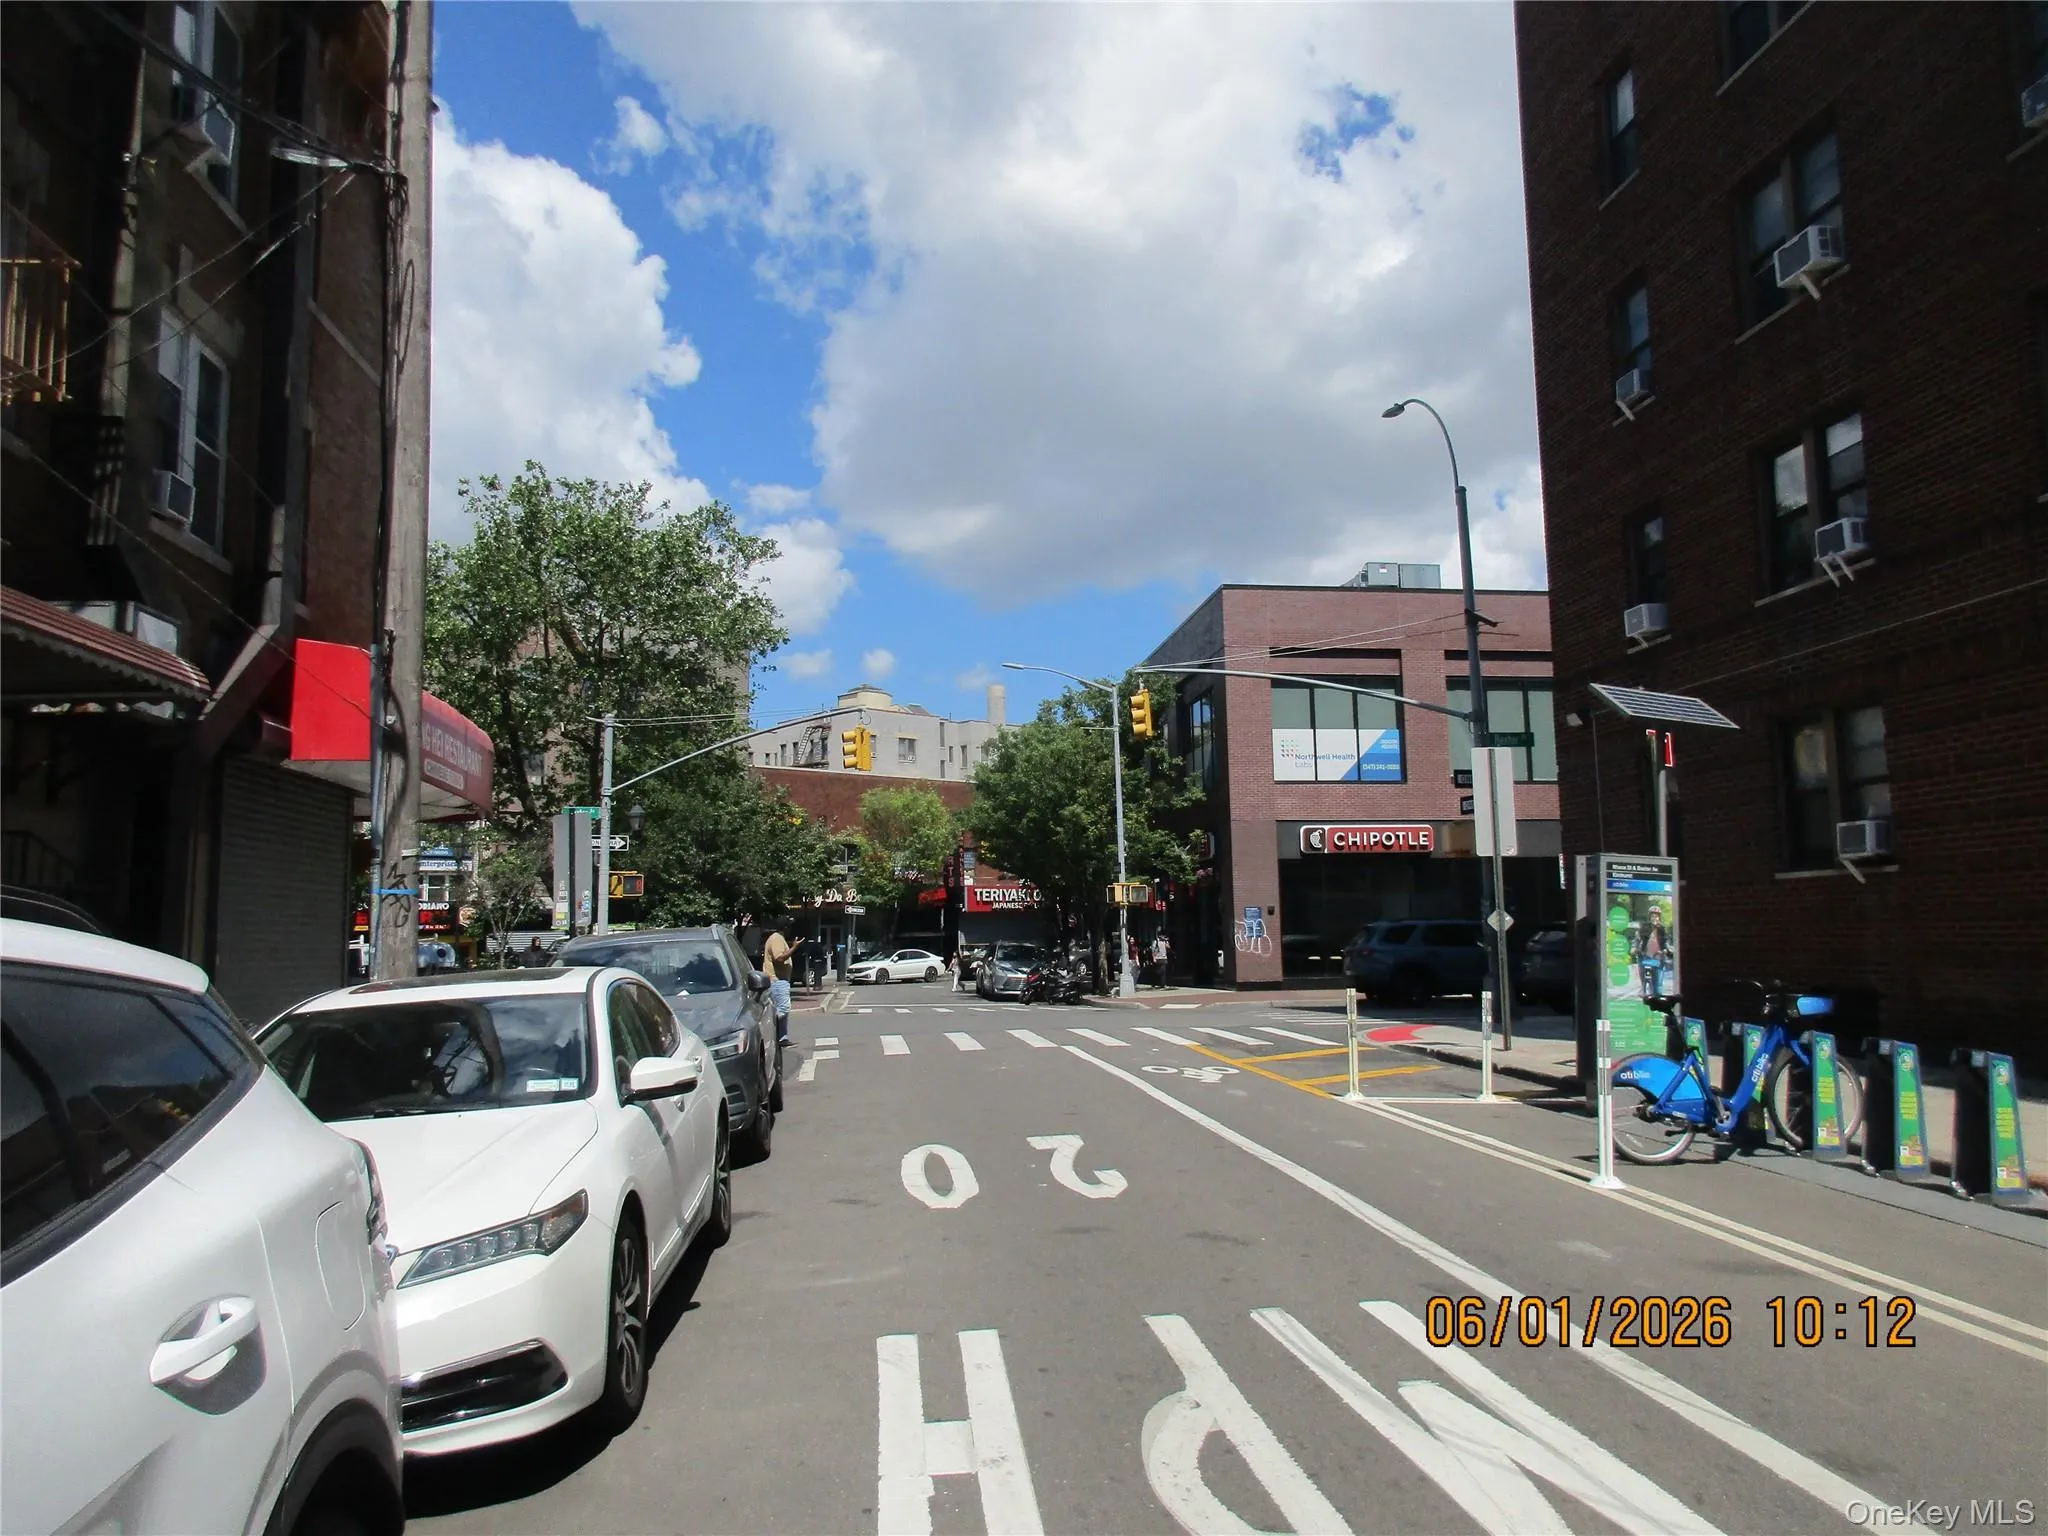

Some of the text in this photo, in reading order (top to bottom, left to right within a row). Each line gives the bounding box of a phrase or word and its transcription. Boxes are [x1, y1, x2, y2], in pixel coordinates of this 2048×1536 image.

[1332, 753, 1356, 761] Health
[1333, 831, 1430, 847] CHIPOTLE
[974, 888, 1031, 902] TERIYAKI
